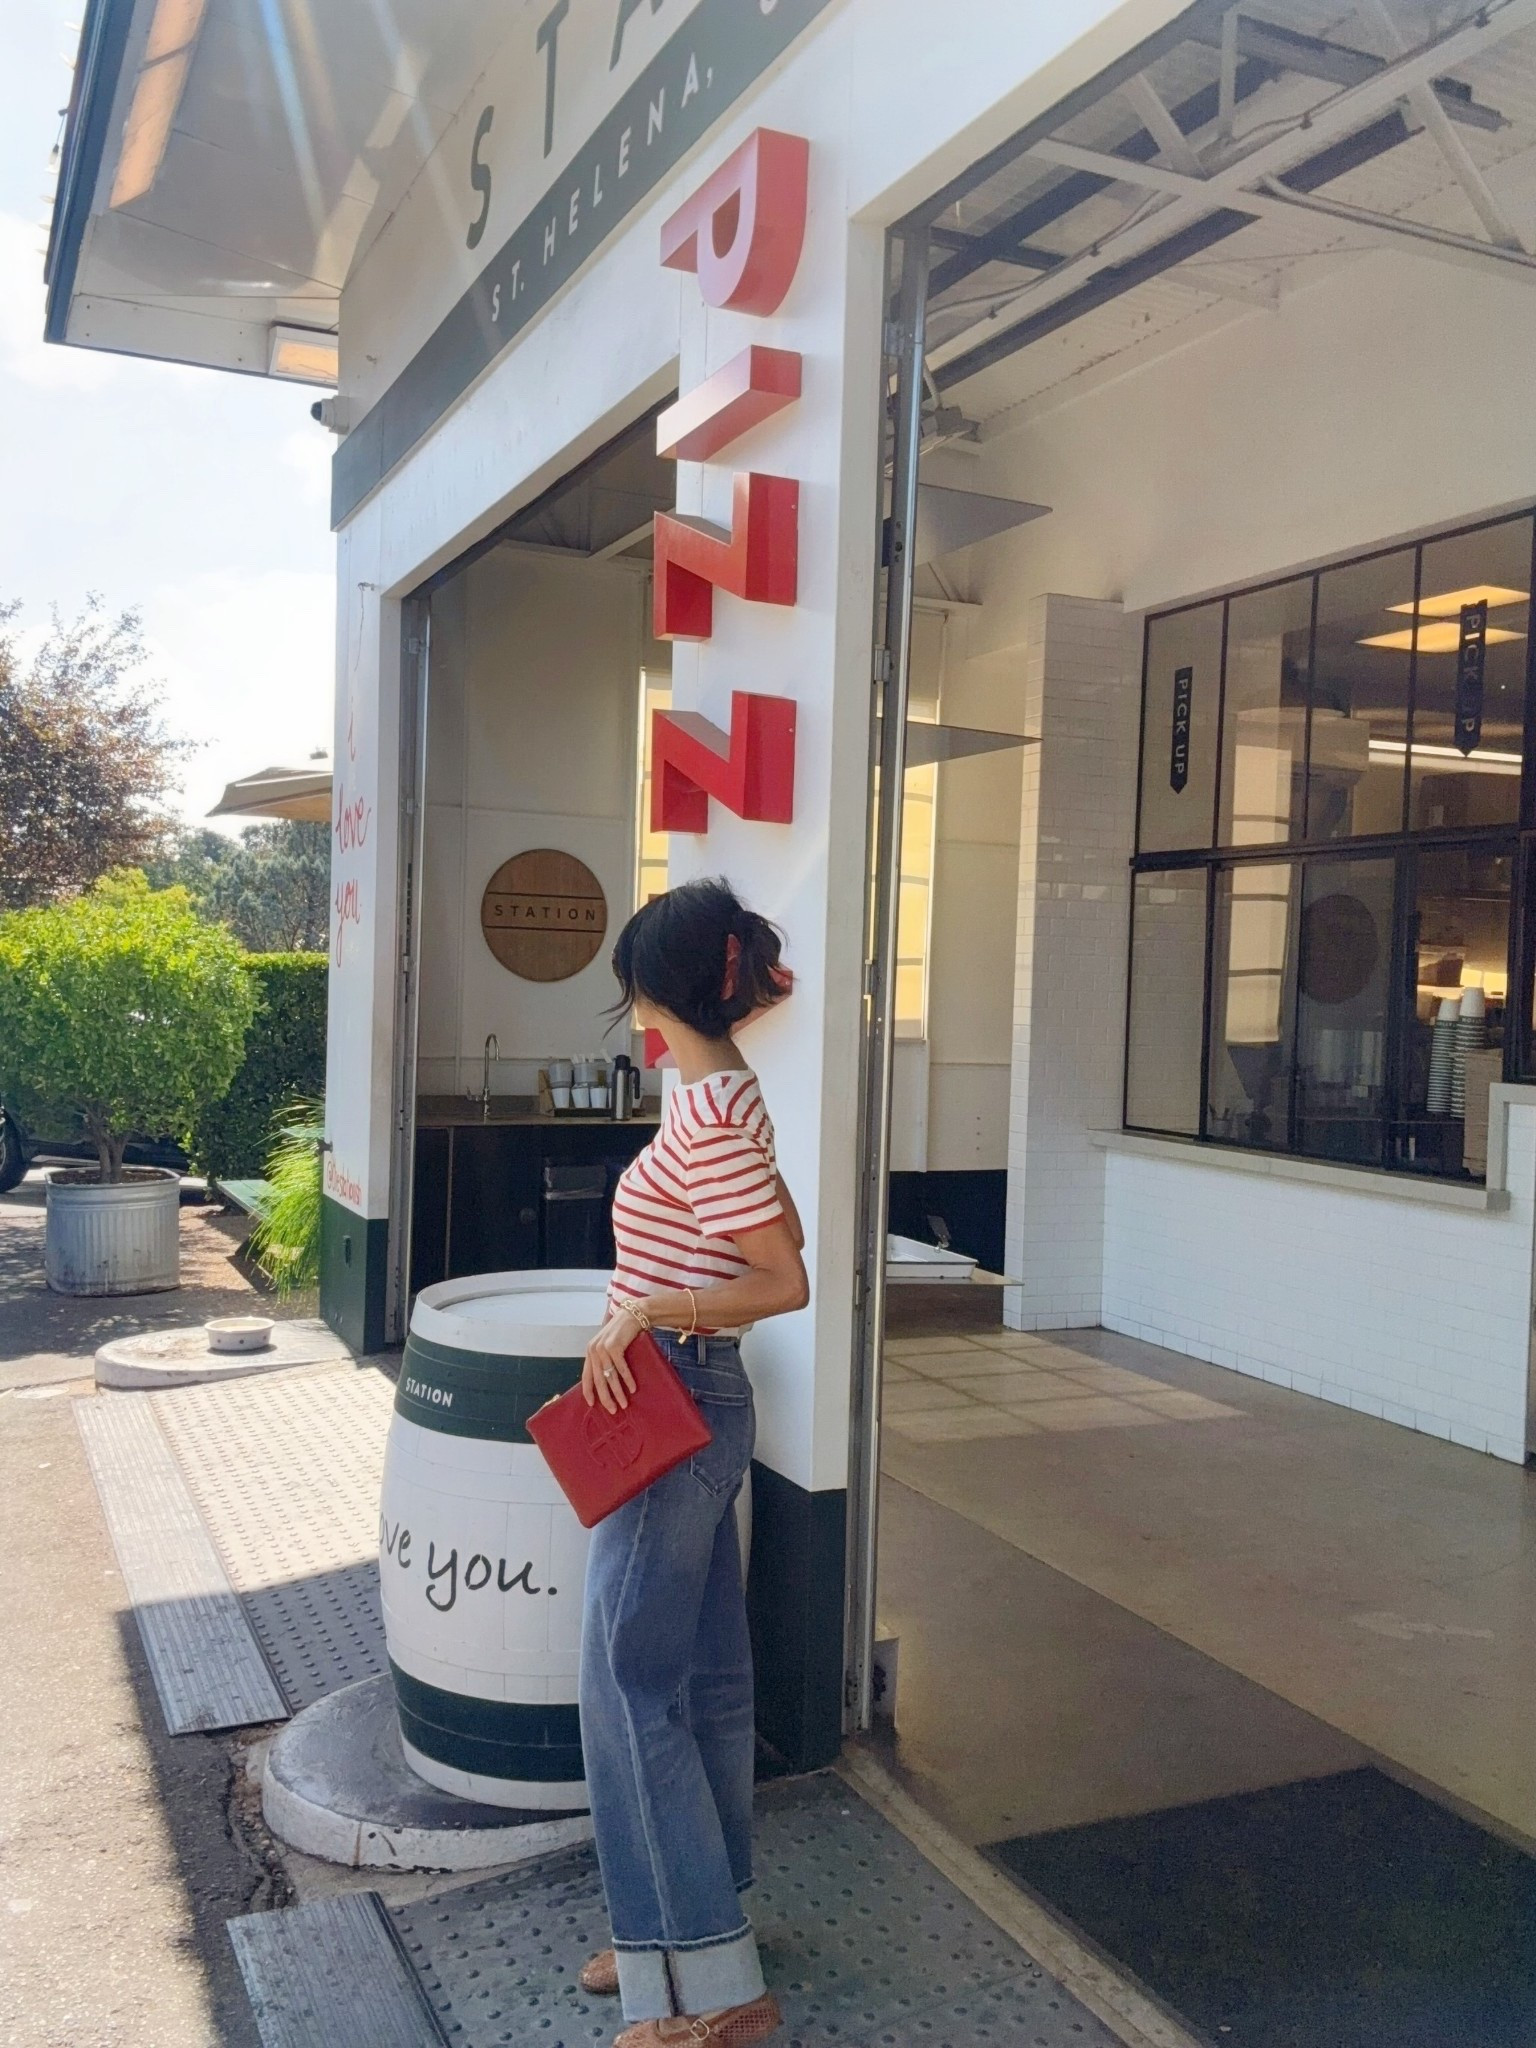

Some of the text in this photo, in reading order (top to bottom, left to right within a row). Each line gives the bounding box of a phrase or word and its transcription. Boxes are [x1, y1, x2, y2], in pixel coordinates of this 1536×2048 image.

[492, 53, 713, 322] ST. HELENA,
[645, 127, 809, 1068] PIZZ
[1175, 679, 1188, 774] PICK UP
[335, 783, 372, 854] love
[494, 904, 599, 922] STATION
[405, 1377, 453, 1408] STATION
[425, 1541, 557, 1612] you.
